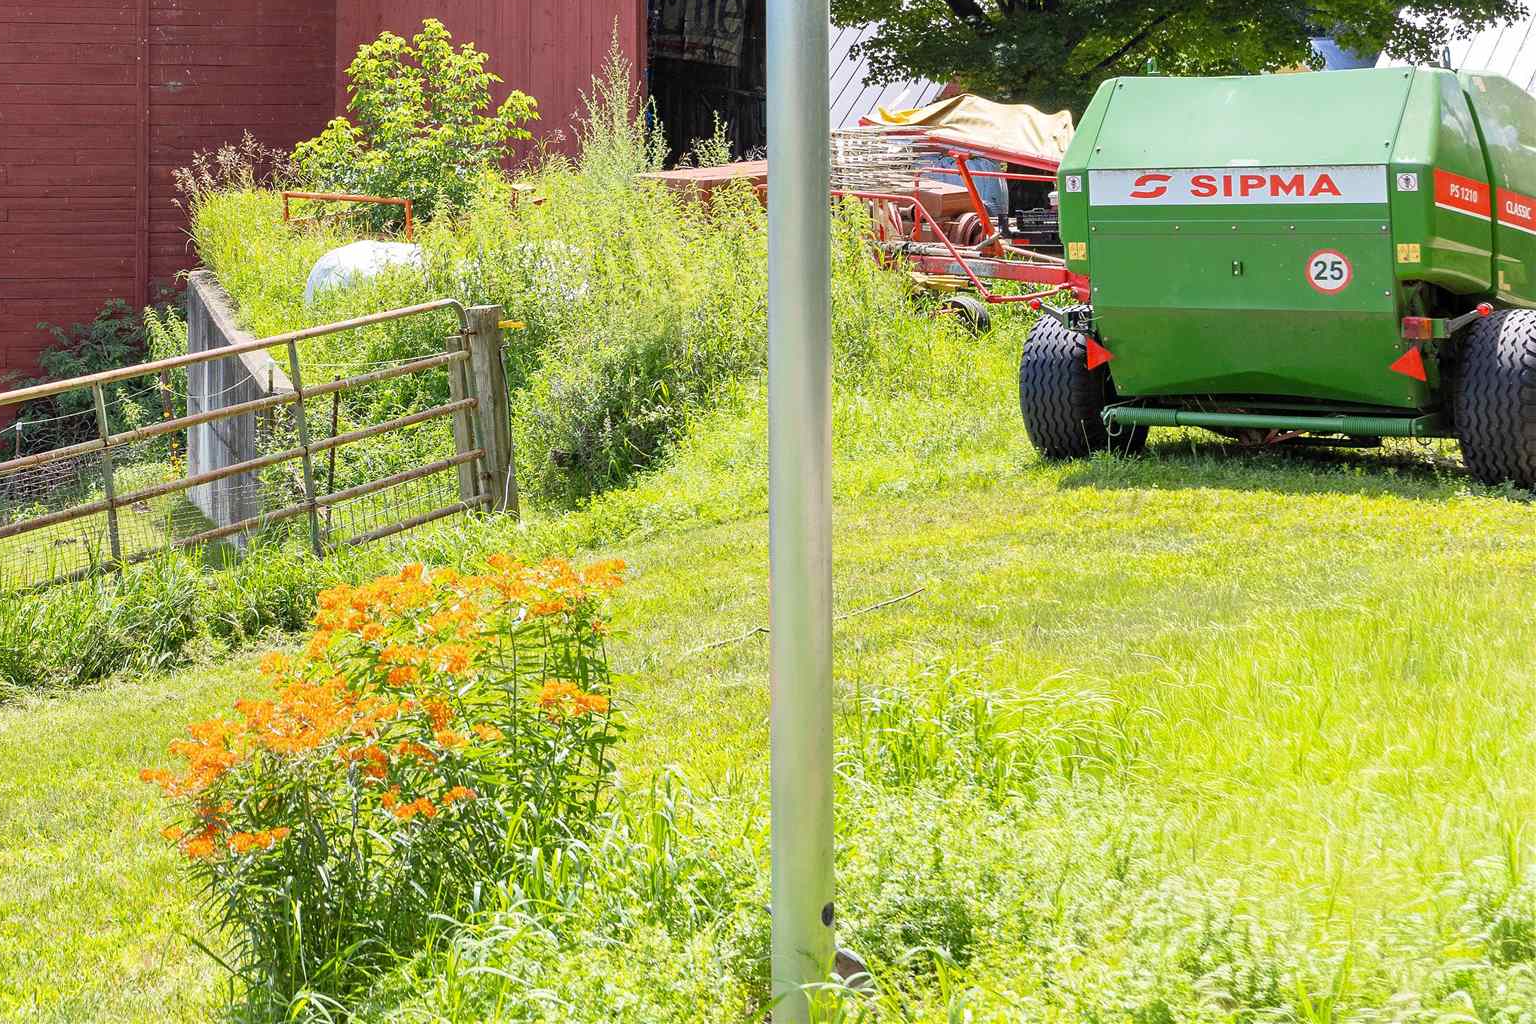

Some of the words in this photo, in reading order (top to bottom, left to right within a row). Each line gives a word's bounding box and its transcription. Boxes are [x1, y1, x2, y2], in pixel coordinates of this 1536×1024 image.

[1190, 174, 1342, 198] SIPMA
[1505, 200, 1532, 220] CLASSIC
[1313, 260, 1344, 281] 25
